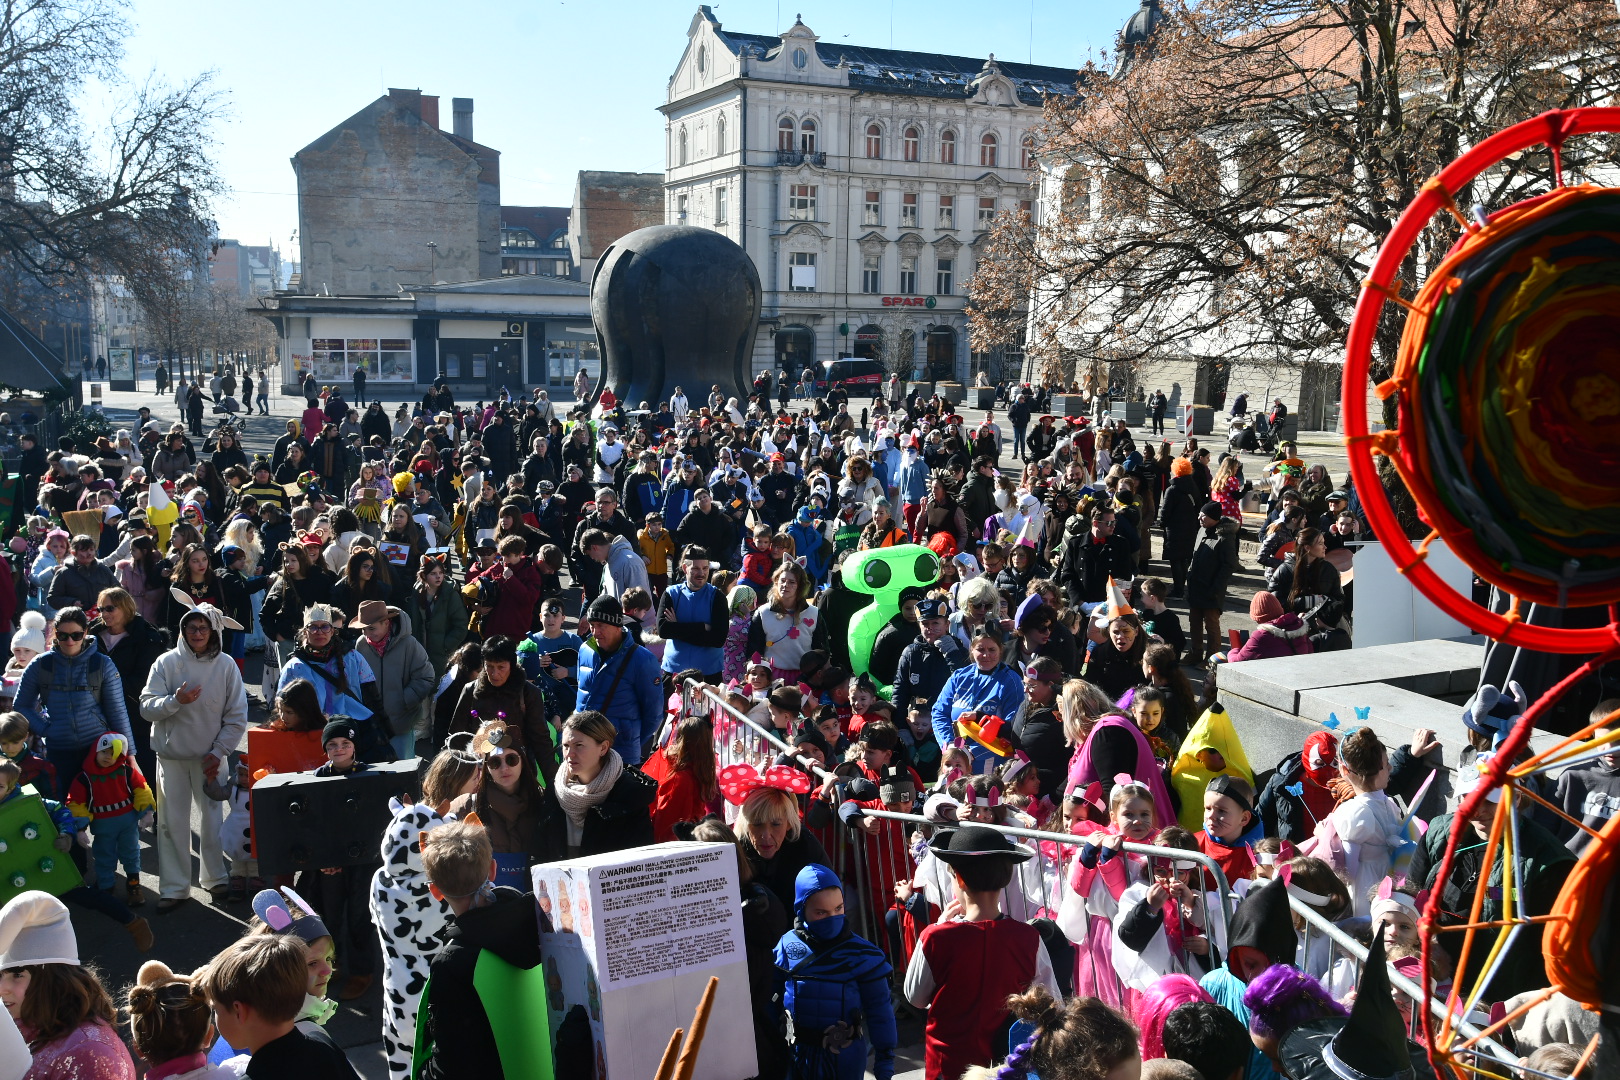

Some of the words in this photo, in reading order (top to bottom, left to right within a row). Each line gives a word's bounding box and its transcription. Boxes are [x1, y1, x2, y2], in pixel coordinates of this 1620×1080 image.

[882, 296, 924, 306] SPAR
[510, 323, 522, 334] Q
[606, 864, 643, 876] WARNING!
